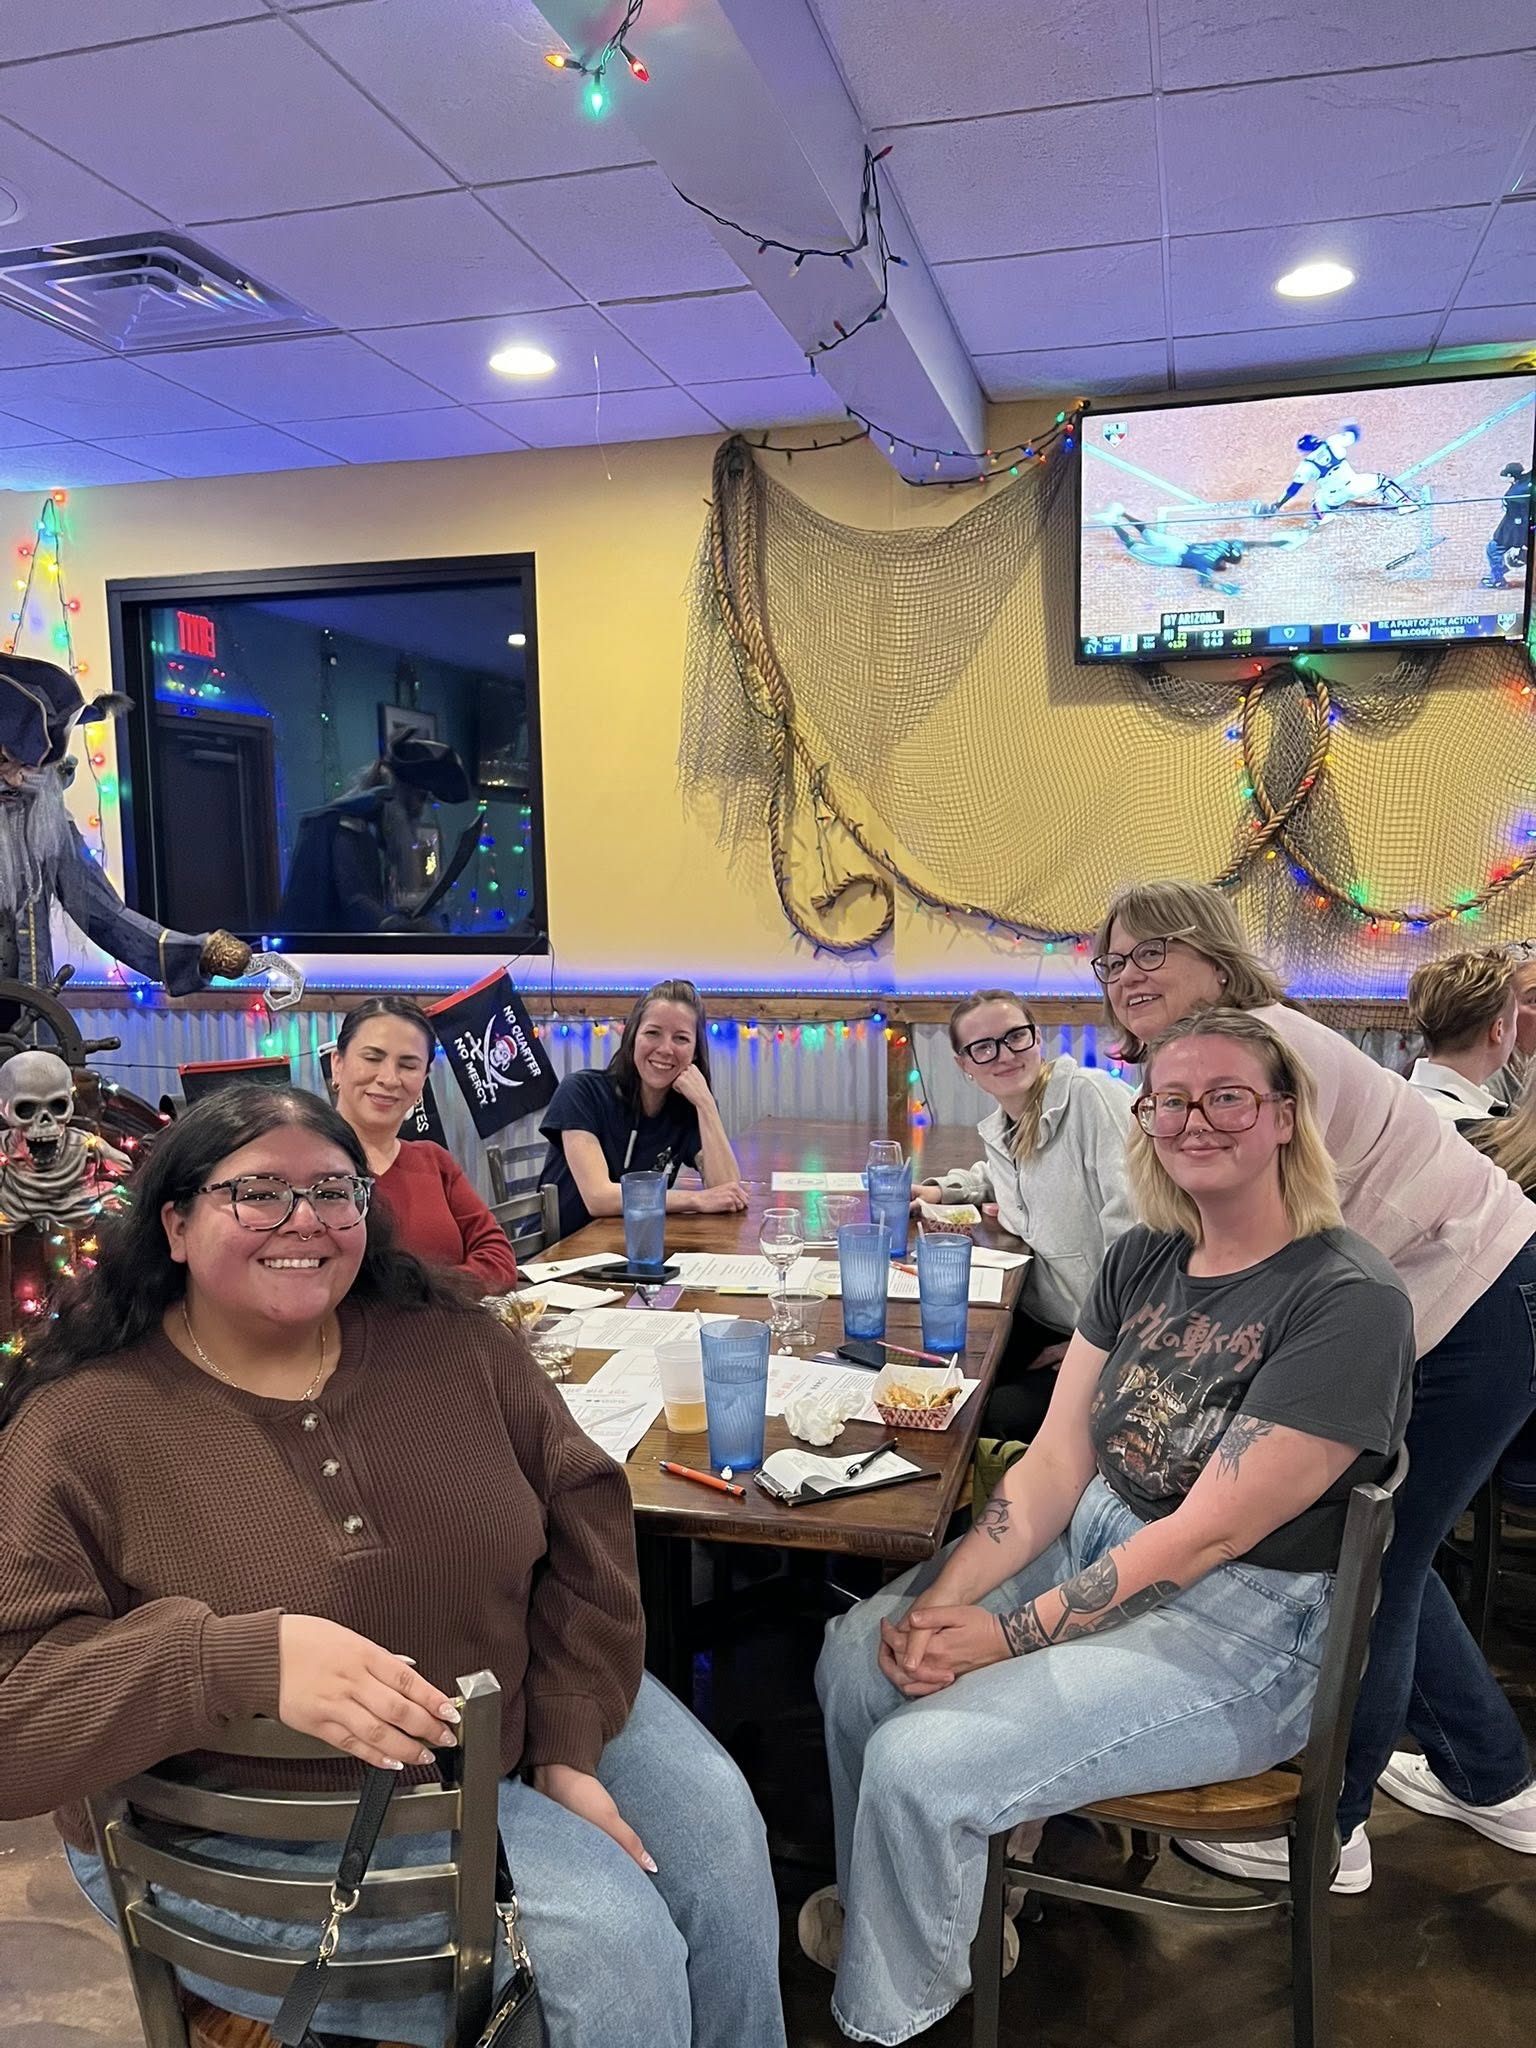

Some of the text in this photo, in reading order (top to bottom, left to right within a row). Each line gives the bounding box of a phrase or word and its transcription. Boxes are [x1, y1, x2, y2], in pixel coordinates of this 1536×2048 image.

[1378, 621, 1390, 629] BE
[1397, 619, 1418, 628] PART
[1419, 618, 1431, 627] OF
[1431, 617, 1448, 626] THE
[1449, 616, 1479, 625] ACTION
[453, 1037, 489, 1106] NO MERCY
[503, 1004, 542, 1078] NO QUARTER
